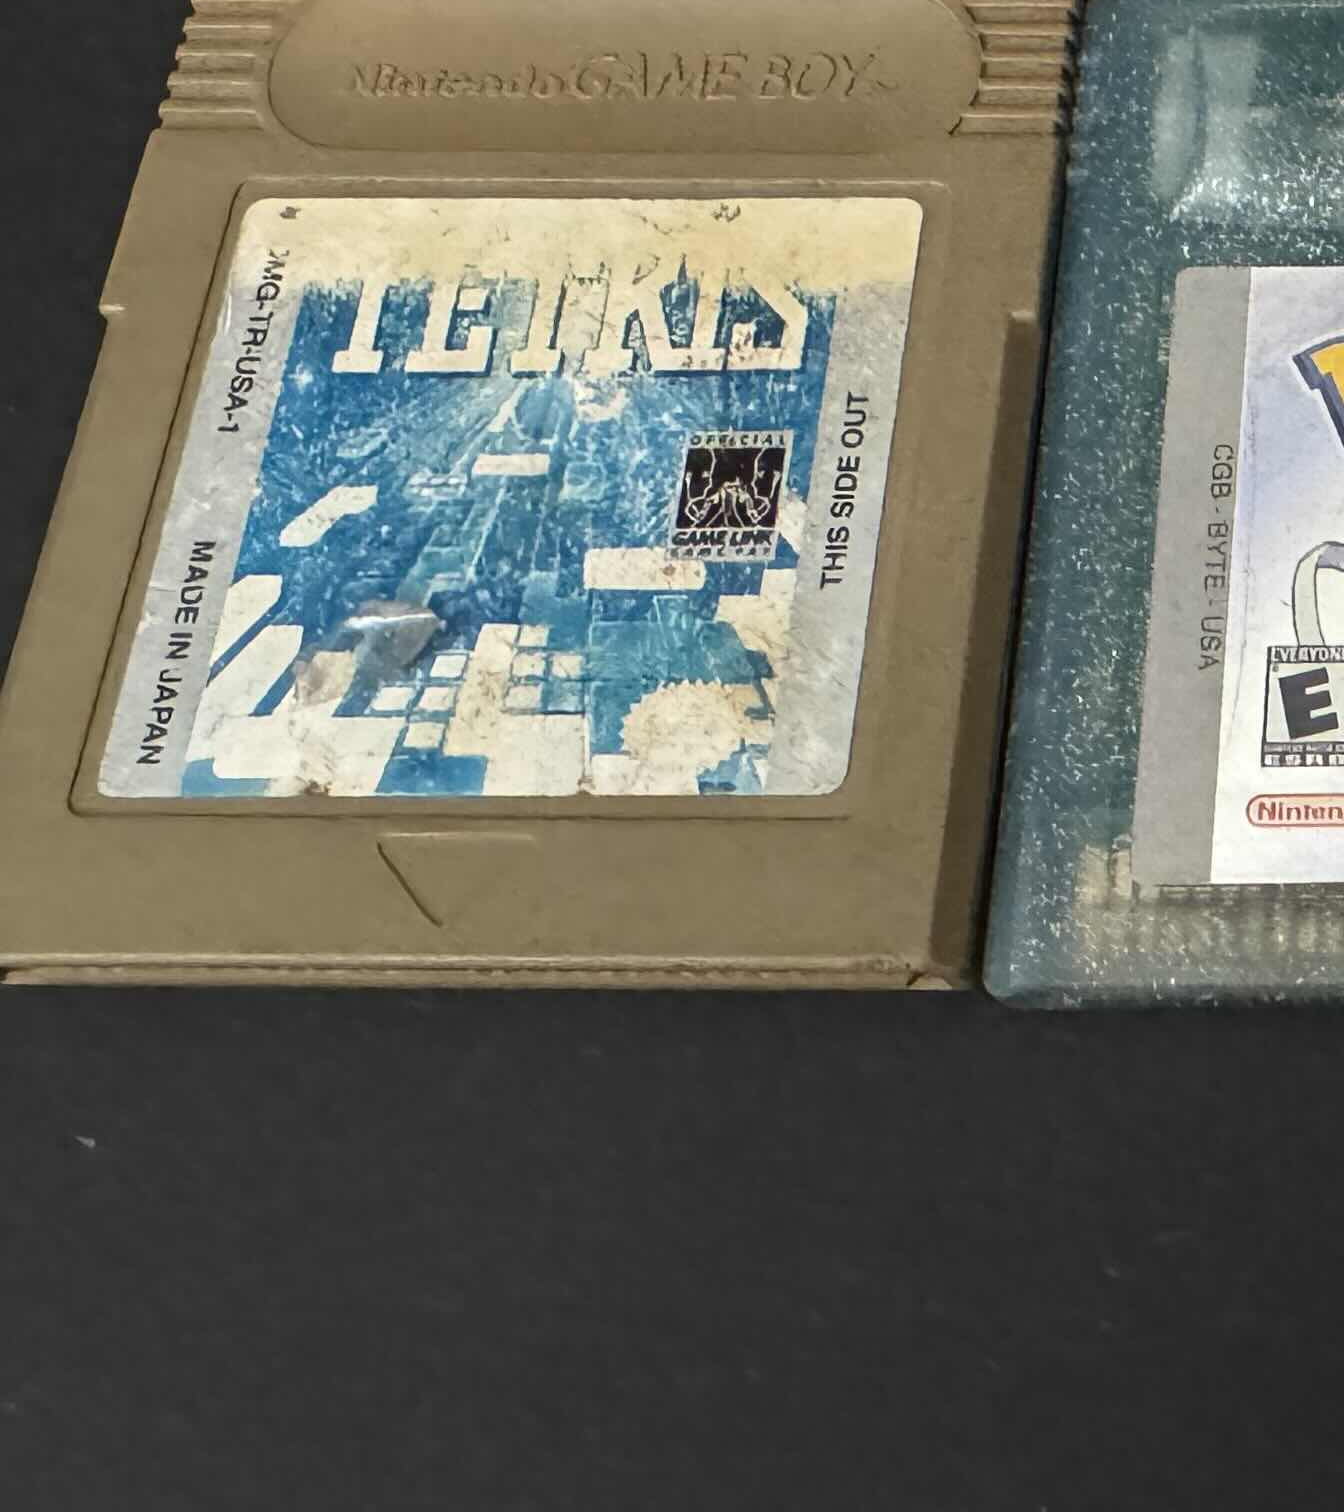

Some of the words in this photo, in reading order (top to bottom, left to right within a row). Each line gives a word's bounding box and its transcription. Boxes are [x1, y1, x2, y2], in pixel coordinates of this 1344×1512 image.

[757, 50, 880, 101] BOY
[841, 390, 869, 450] OUT
[829, 454, 861, 519] SIDE
[671, 530, 725, 546] GAME
[819, 525, 850, 590] THIS
[173, 539, 218, 625] MADE
[168, 630, 194, 663] IN
[135, 667, 184, 767] JAPAN
[1278, 666, 1339, 741] E
